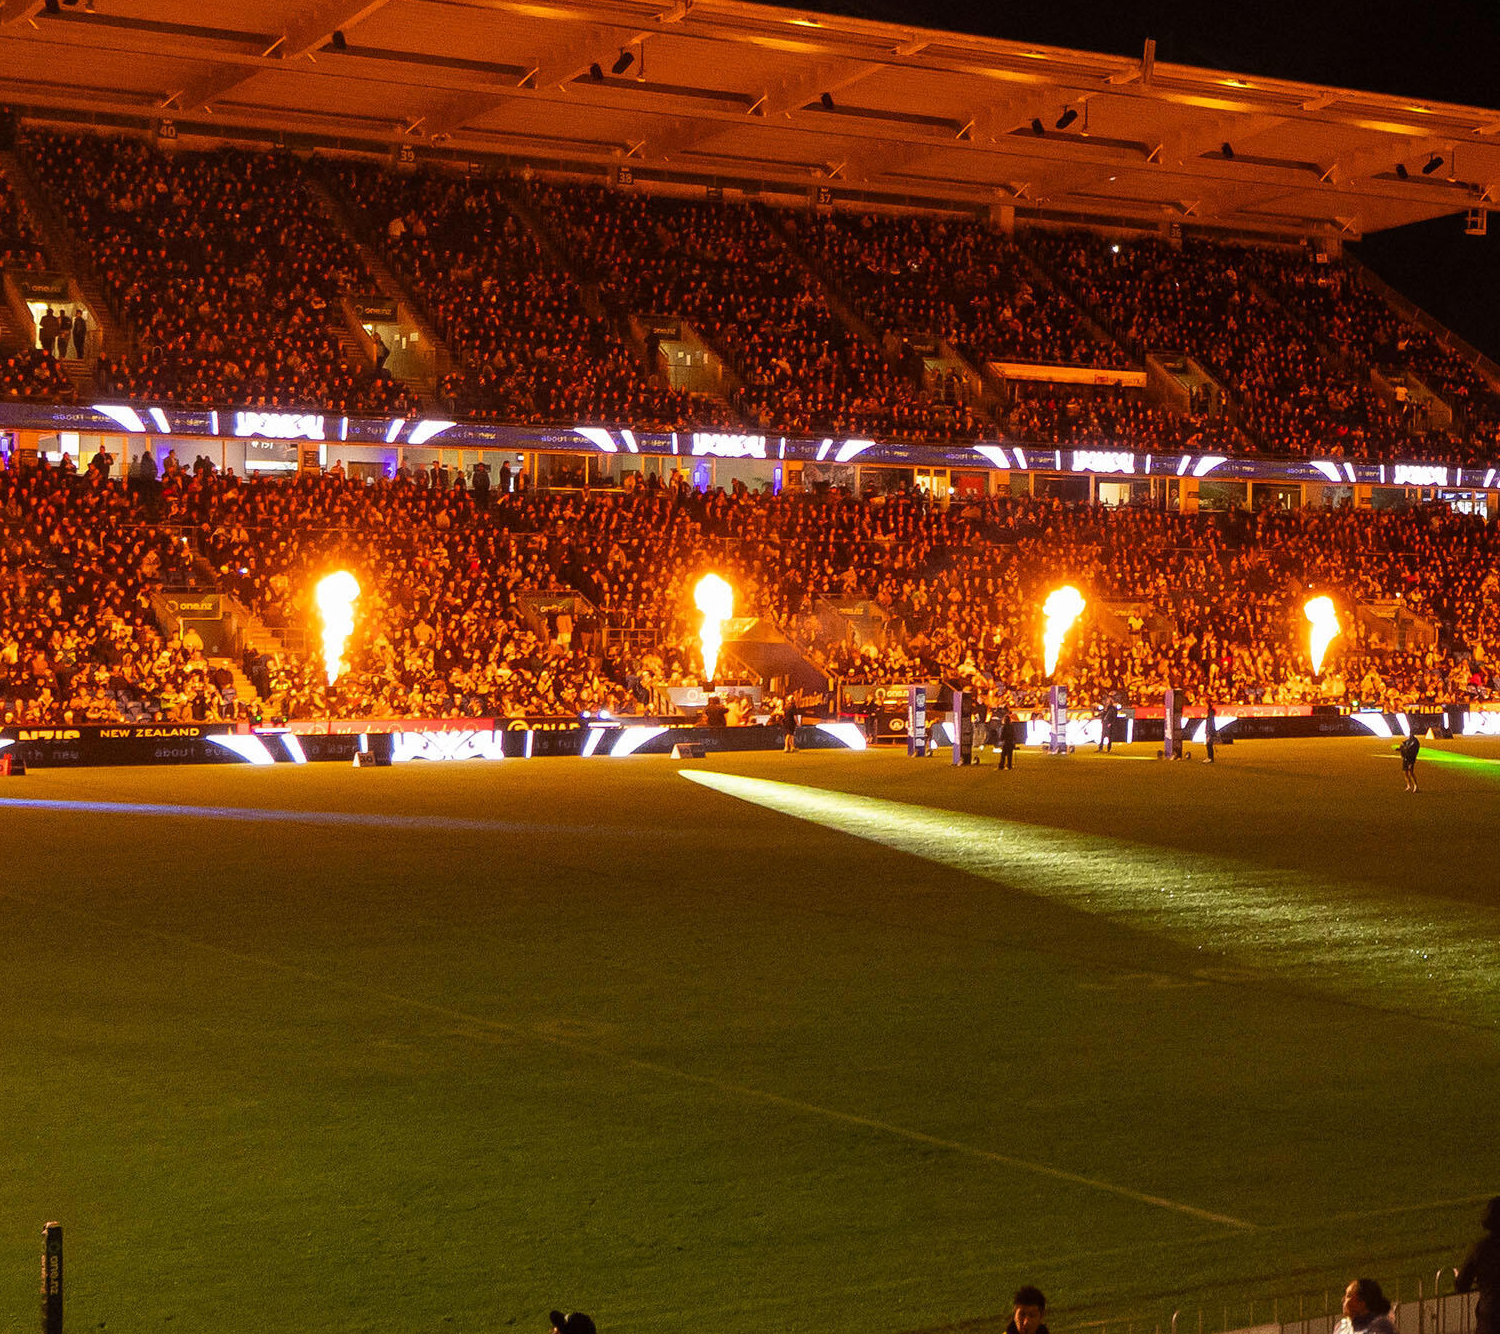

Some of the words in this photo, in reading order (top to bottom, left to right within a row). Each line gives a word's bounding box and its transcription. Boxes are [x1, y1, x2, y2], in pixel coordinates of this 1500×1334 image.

[159, 125, 177, 138] 40
[400, 149, 415, 163] 39
[618, 172, 633, 185] 38
[818, 192, 832, 204] 37
[179, 602, 213, 611] one.nz
[99, 728, 131, 739] NEW
[134, 726, 201, 738] ZEALAND
